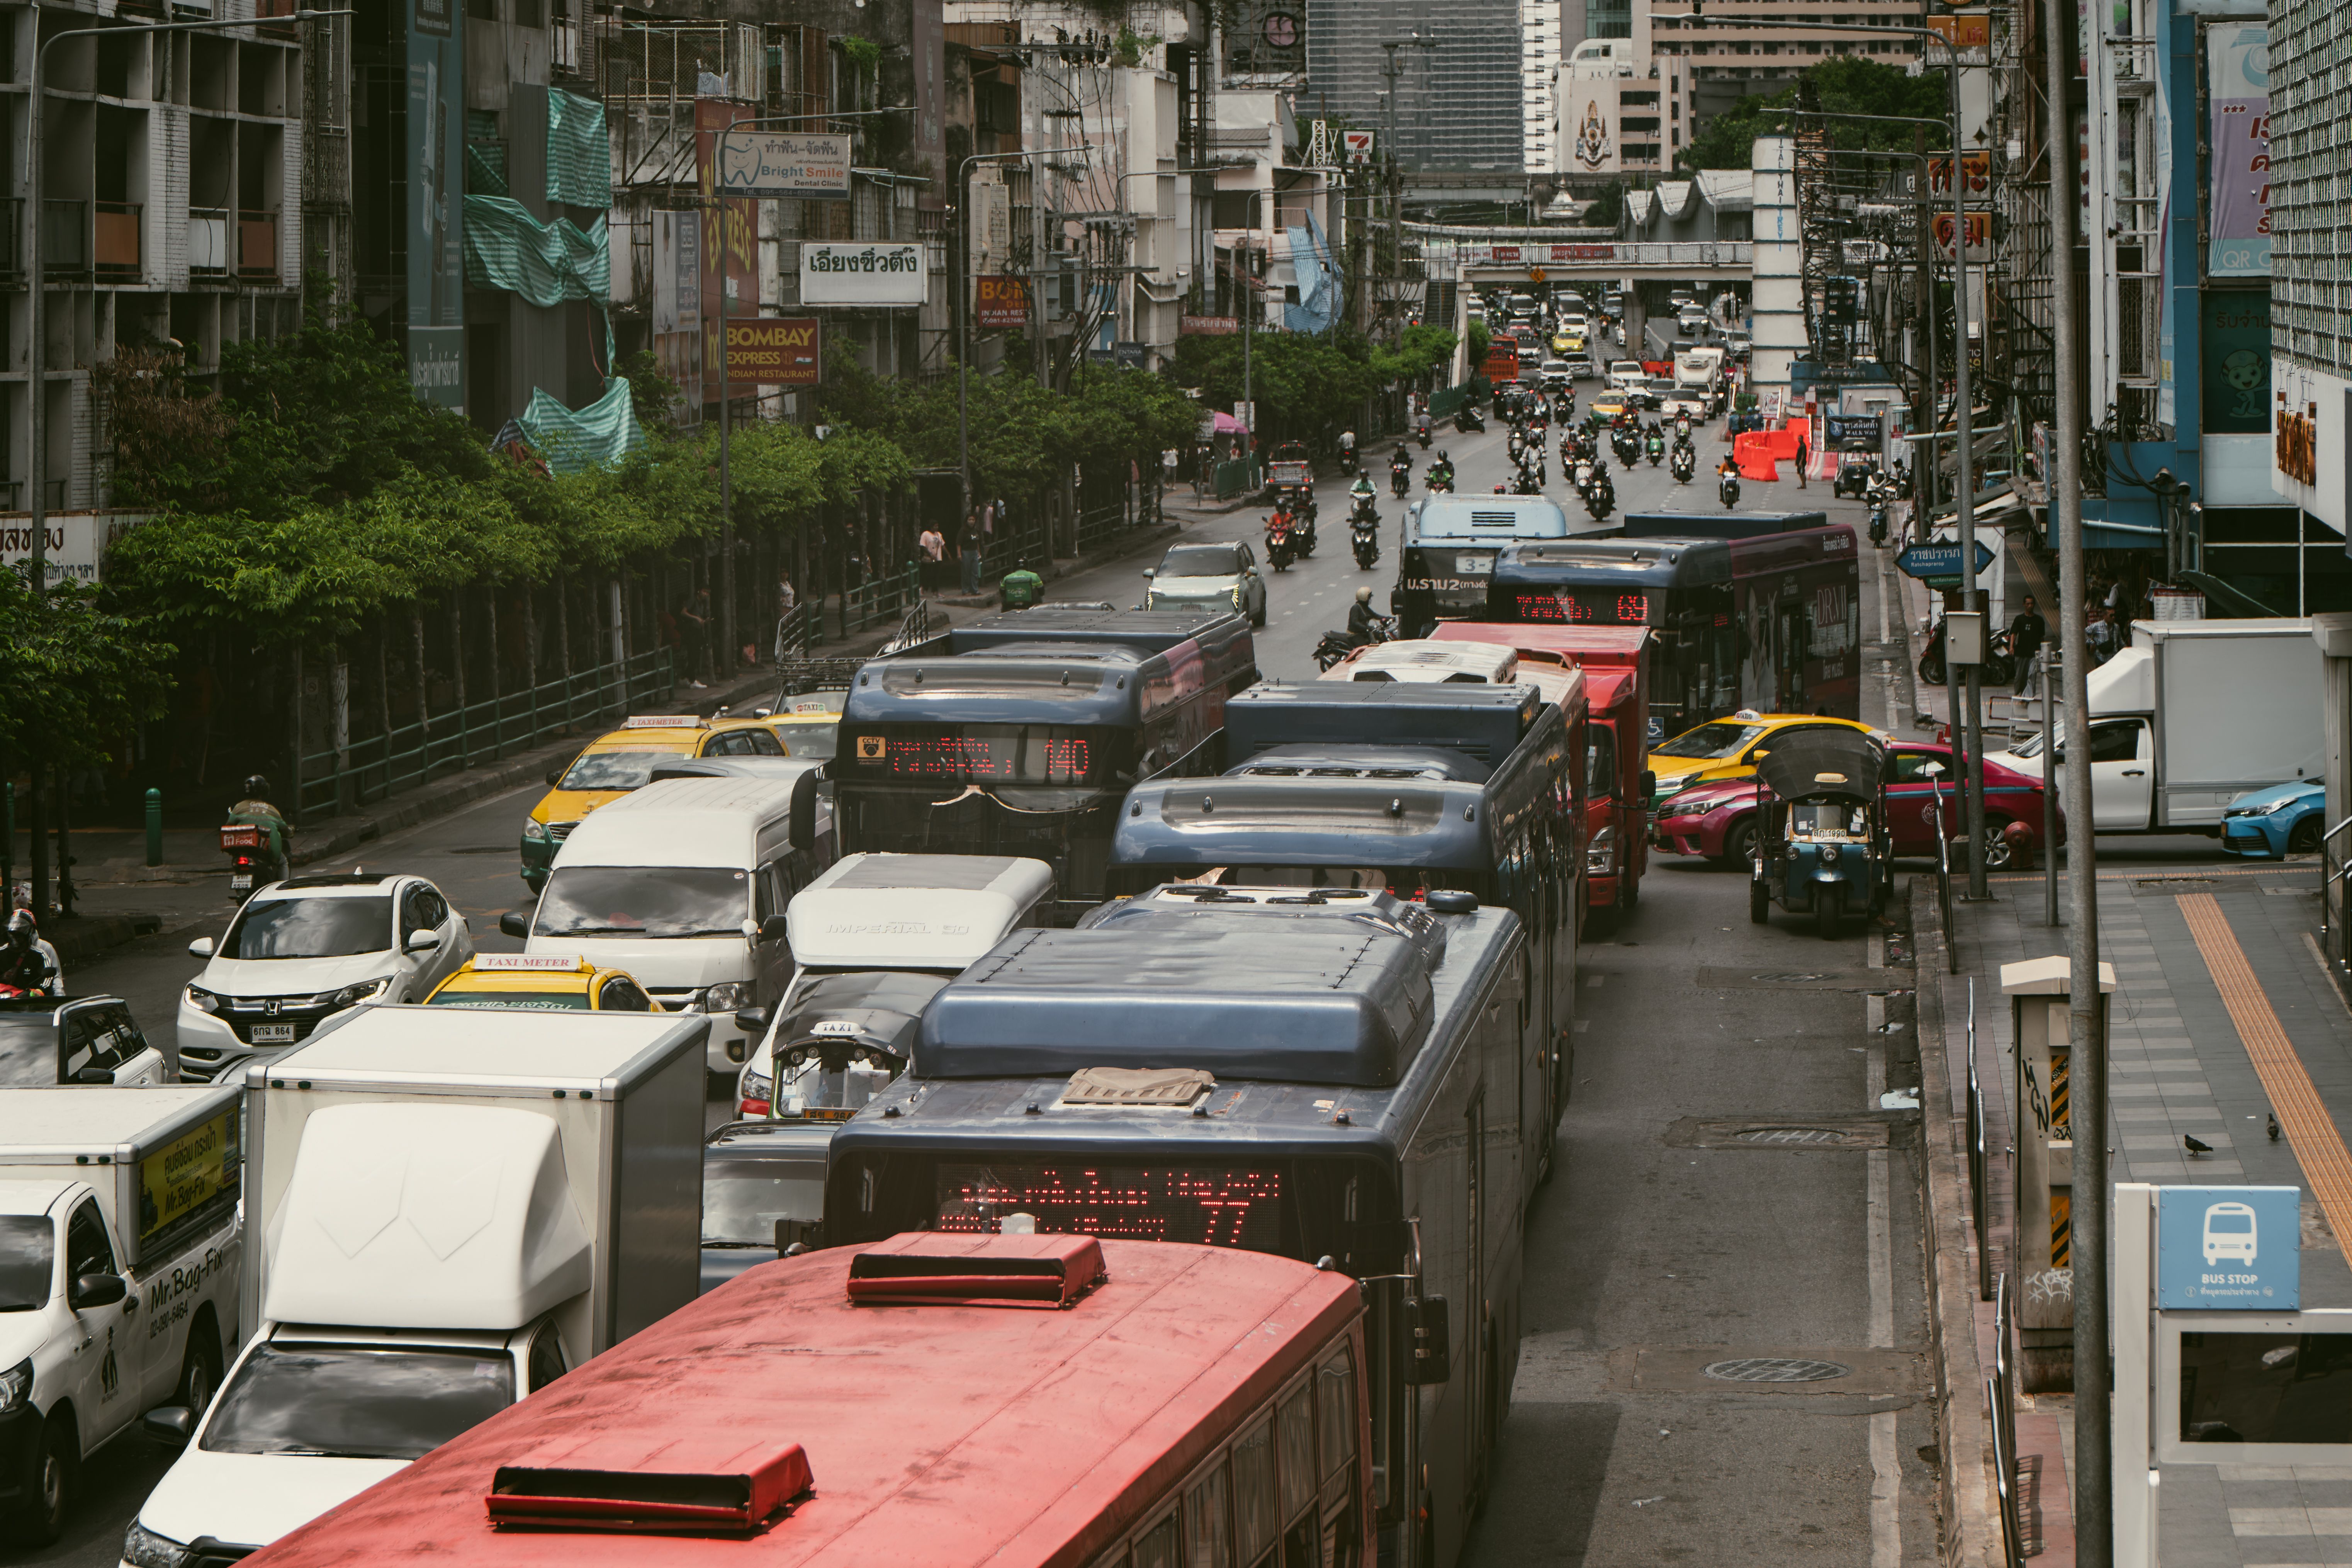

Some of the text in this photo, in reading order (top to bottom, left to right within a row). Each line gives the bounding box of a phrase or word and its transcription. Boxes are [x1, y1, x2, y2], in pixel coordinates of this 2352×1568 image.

[765, 139, 837, 155] ทำฟัน-จัดฟัน
[761, 166, 843, 178] Bright Smile
[708, 207, 751, 275] EXRESS
[2223, 250, 2250, 268] QR
[727, 327, 815, 346] BOMBAY
[727, 352, 781, 365] EXPRESS
[759, 370, 815, 378] RESTAURANT
[1618, 596, 1647, 620] 69
[1044, 740, 1087, 774] 140
[825, 925, 931, 933] IMPERIAL
[486, 958, 569, 967] TAXI METER
[275, 1026, 290, 1035] 864
[165, 1176, 205, 1216] Mr.Bag-Fix
[1200, 1201, 1250, 1243] 77
[151, 1247, 223, 1314] Mr.Bag-Fix
[2202, 1274, 2258, 1284] BUS STOP
